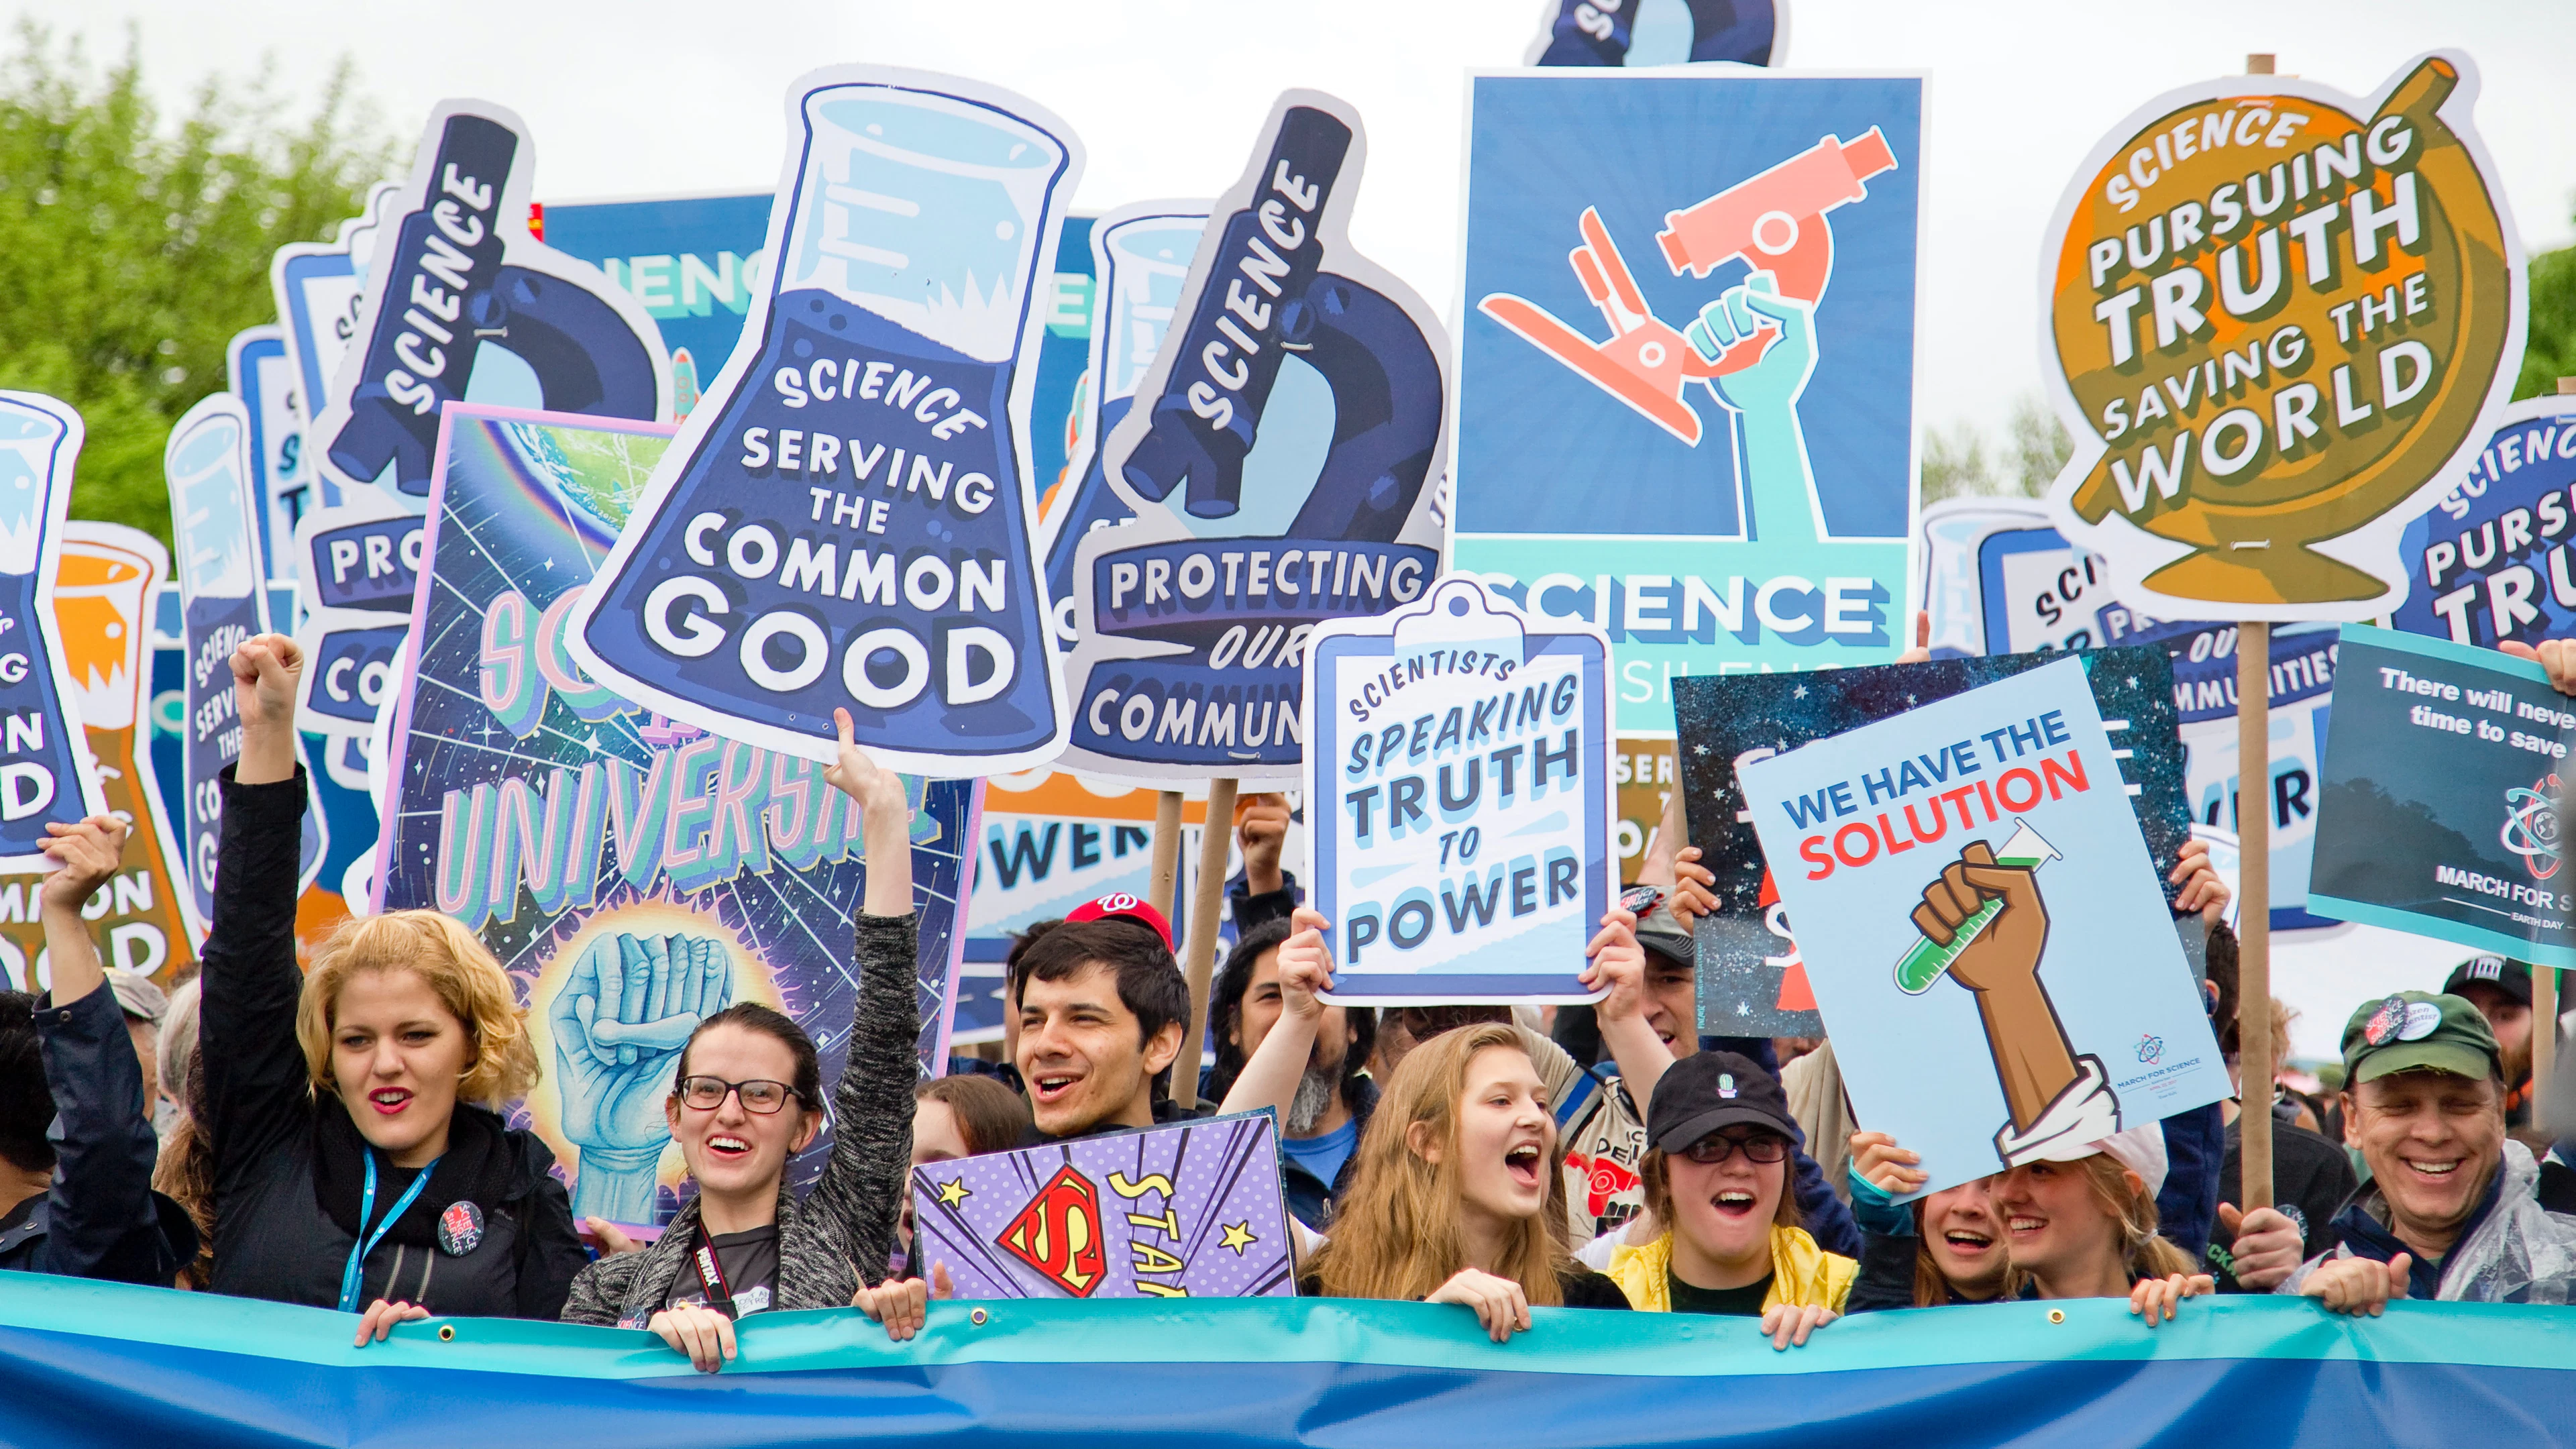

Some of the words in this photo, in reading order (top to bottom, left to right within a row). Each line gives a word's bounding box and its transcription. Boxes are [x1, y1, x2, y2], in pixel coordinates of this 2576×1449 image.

[2105, 107, 2310, 214] SCIENCE
[2088, 115, 2414, 289] PURSUING
[384, 162, 492, 416] SCIENCE
[1187, 158, 1319, 431] SCIENCE
[2094, 170, 2421, 368] TRUTH
[2102, 325, 2306, 440] SAVING
[2328, 272, 2428, 343] THE
[773, 358, 988, 441] SCIENCE
[2110, 339, 2434, 515] WORLD
[741, 426, 995, 514] SERVING
[2439, 425, 2576, 521] SCIENC
[808, 486, 891, 535] THE
[2424, 483, 2576, 587] PURS
[684, 511, 1006, 612] COMMON
[1111, 549, 1424, 609] PROTECTING
[2434, 543, 2576, 646] TRU
[643, 574, 1016, 708] GOOD
[1208, 624, 1315, 669] OUR
[2189, 627, 2239, 663] OU
[1088, 688, 1303, 749] COMMUN
[1349, 650, 1516, 722] SCIENTISTS
[2379, 666, 2461, 701] There
[2465, 688, 2513, 714] will
[2518, 699, 2576, 731] neve
[217, 724, 243, 761] THE
[1347, 674, 1578, 775] SPEAKING
[2410, 704, 2473, 735] time
[2477, 718, 2505, 743] to
[2510, 731, 2567, 759] save
[1346, 729, 1578, 838] TRUTH
[1781, 781, 1860, 831] WE
[1860, 740, 1982, 806] HAVE
[1981, 709, 2071, 764] THE
[1440, 826, 1480, 865] TO
[1799, 749, 2092, 882] SOLUTION
[1348, 857, 1580, 964] POWER
[2436, 865, 2510, 900] MARCH
[2513, 883, 2554, 911] FOR
[2511, 912, 2542, 928] EARTH
[2542, 918, 2565, 930] DAY
[2366, 999, 2404, 1032] SCIENCE
[2370, 1014, 2404, 1044] SILENCE
[2377, 1014, 2395, 1031] NOT
[2117, 1075, 2147, 1089] MARCH
[2147, 1069, 2165, 1080] FOR
[2165, 1057, 2202, 1073] SCIENCE
[445, 1212, 462, 1254] SILENCE
[455, 1219, 466, 1240] NOT
[459, 1205, 477, 1251] SCIENCE
[696, 1246, 720, 1287] PENTAX
